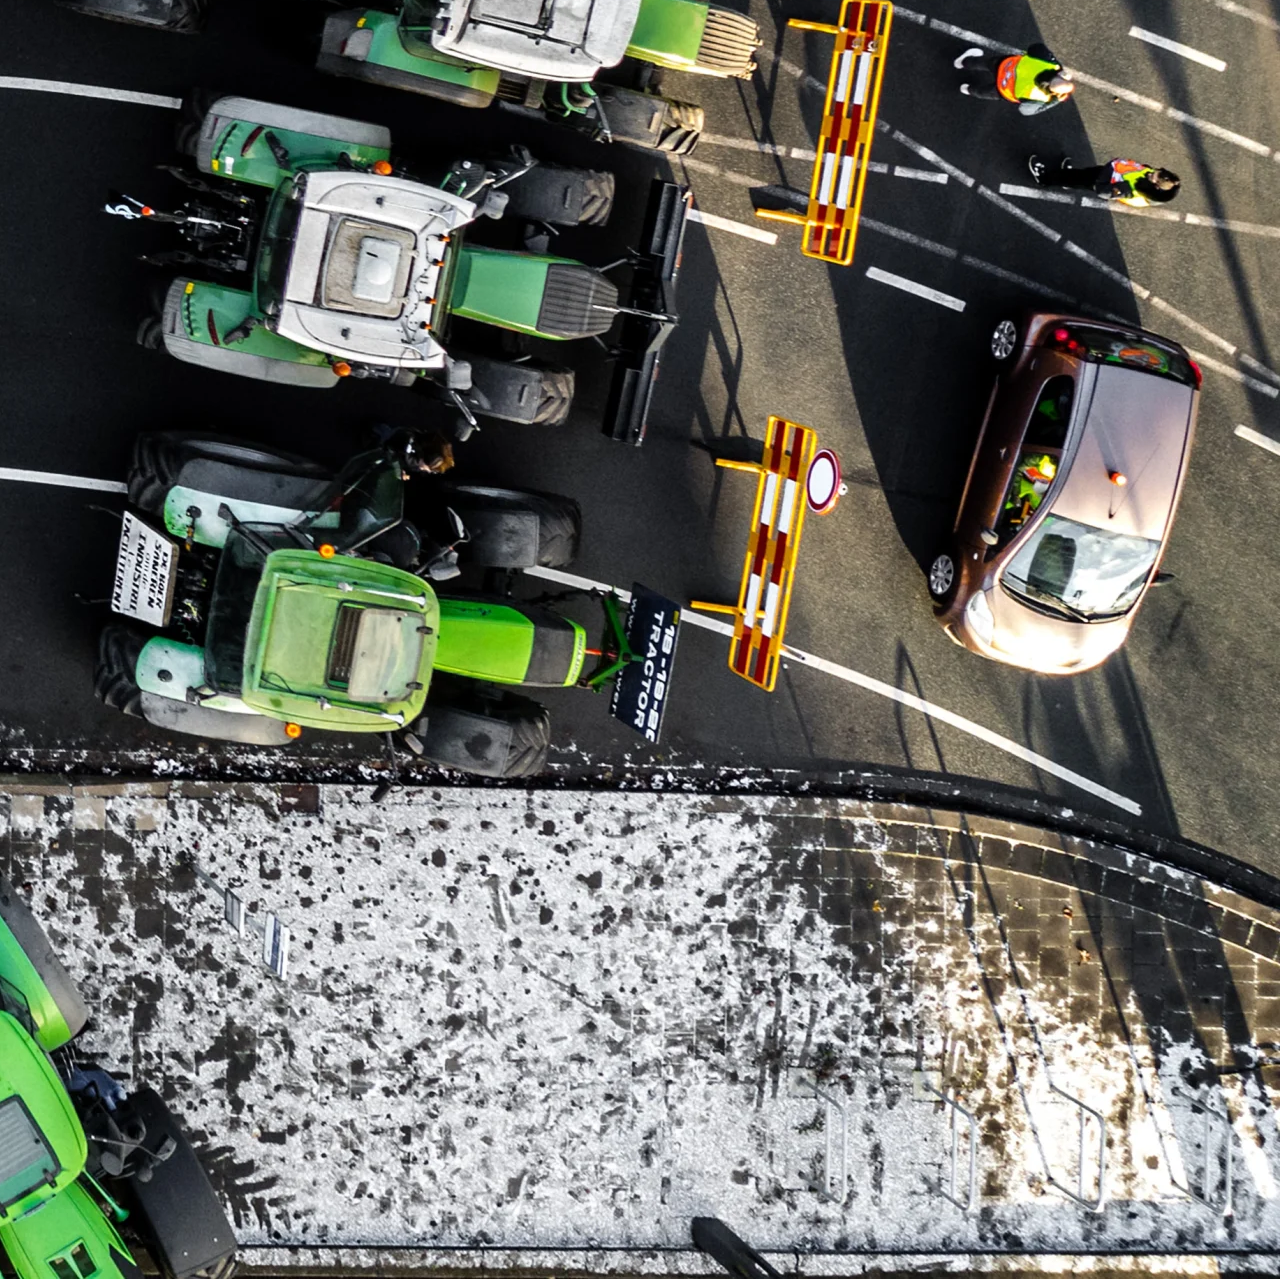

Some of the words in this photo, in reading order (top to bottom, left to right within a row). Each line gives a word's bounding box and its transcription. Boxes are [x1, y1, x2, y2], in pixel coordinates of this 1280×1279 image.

[130, 531, 147, 614] INDUSTRIE
[147, 540, 162, 609] SANEREN
[155, 574, 166, 609] BOER
[160, 551, 169, 570] DE
[634, 610, 665, 729] TRACTOR
